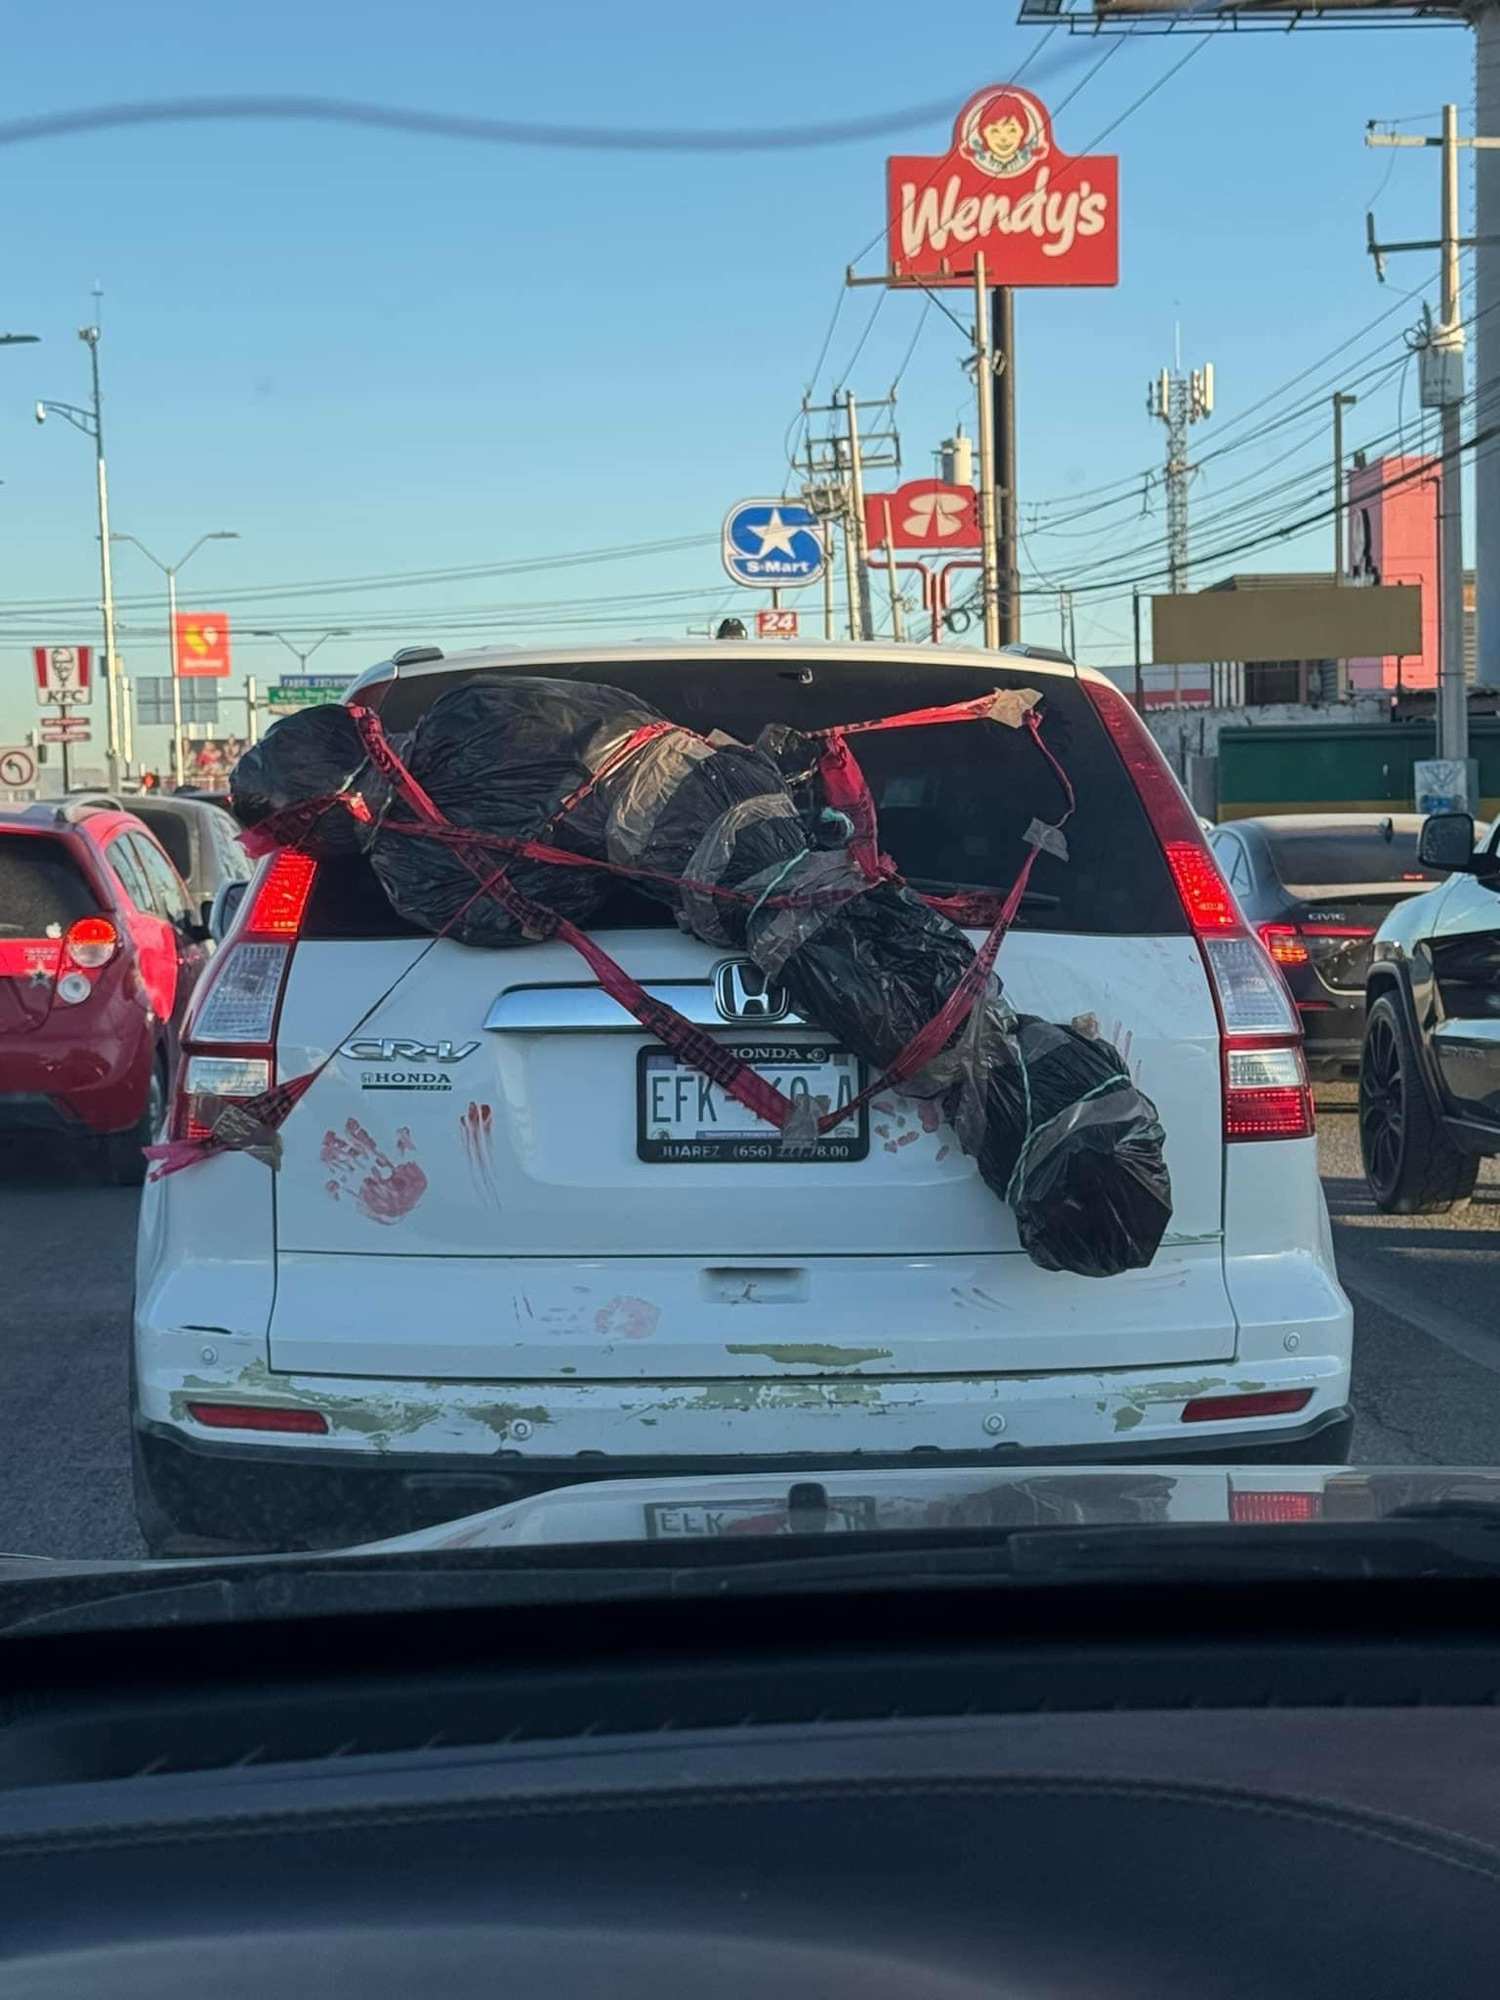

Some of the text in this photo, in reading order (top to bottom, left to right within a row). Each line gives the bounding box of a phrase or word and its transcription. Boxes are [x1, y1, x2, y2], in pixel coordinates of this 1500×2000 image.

[901, 166, 1107, 257] Wendy's
[762, 612, 794, 630] 24
[47, 690, 84, 703] KFC
[1308, 913, 1345, 921] CIVIC
[338, 1038, 482, 1063] CR-V
[375, 1073, 451, 1083] HONDA
[733, 1145, 773, 1158] (656)
